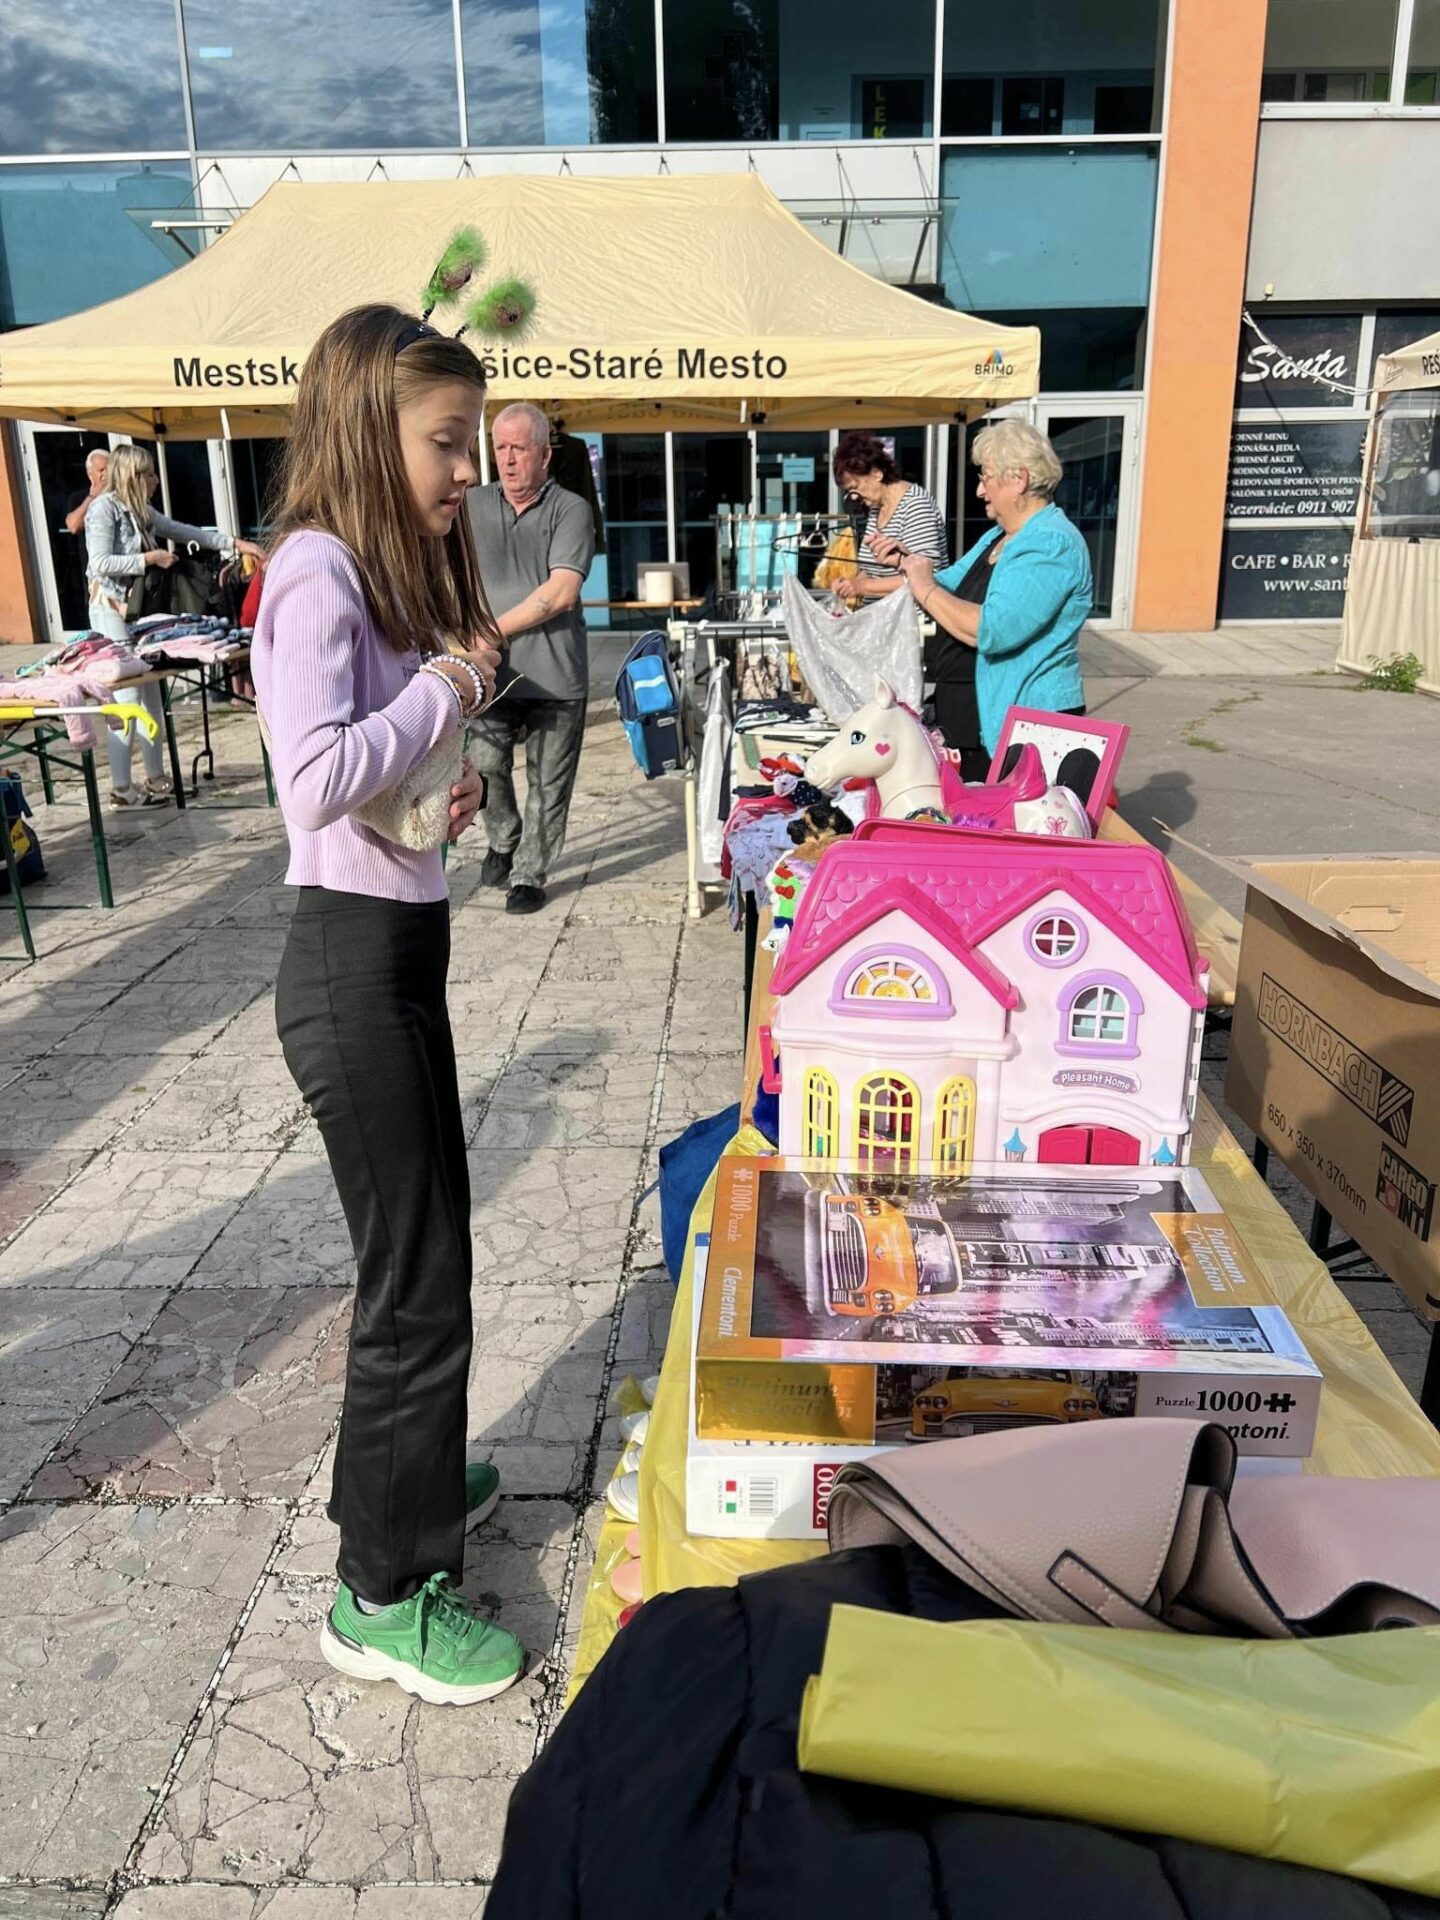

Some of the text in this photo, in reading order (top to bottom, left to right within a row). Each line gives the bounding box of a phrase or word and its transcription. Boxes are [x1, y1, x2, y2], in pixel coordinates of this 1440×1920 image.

[677, 348, 787, 379] Mesto
[975, 364, 1014, 376] BRIMO
[1239, 344, 1348, 383] Santa
[1235, 432, 1289, 441] DENNÉ MENU
[1234, 443, 1300, 453] DONÁŠKA JEDLA
[1270, 454, 1295, 463] AKCIE
[1270, 465, 1304, 475] OSLAVY
[1266, 488, 1273, 497] S
[1273, 487, 1320, 497] KAPACITOU
[1330, 486, 1354, 496] OSÓB
[1297, 500, 1327, 514] 0911
[1331, 500, 1355, 514] 907
[1231, 554, 1276, 569] CAFE
[1292, 553, 1326, 569] BAR
[1261, 980, 1379, 1112] HORNBACH
[1104, 1075, 1131, 1090] Home
[1268, 1103, 1286, 1133] 650
[1296, 1130, 1315, 1162] 350
[1326, 1160, 1367, 1216] 370mm
[1380, 1147, 1428, 1211] CARGO
[727, 1184, 753, 1242] 1000 Puzzle
[1184, 1230, 1227, 1291] Collection
[1203, 1226, 1246, 1283] Platinum
[718, 1267, 742, 1338] Clementoni
[1156, 1391, 1261, 1412] Puzzle 1000
